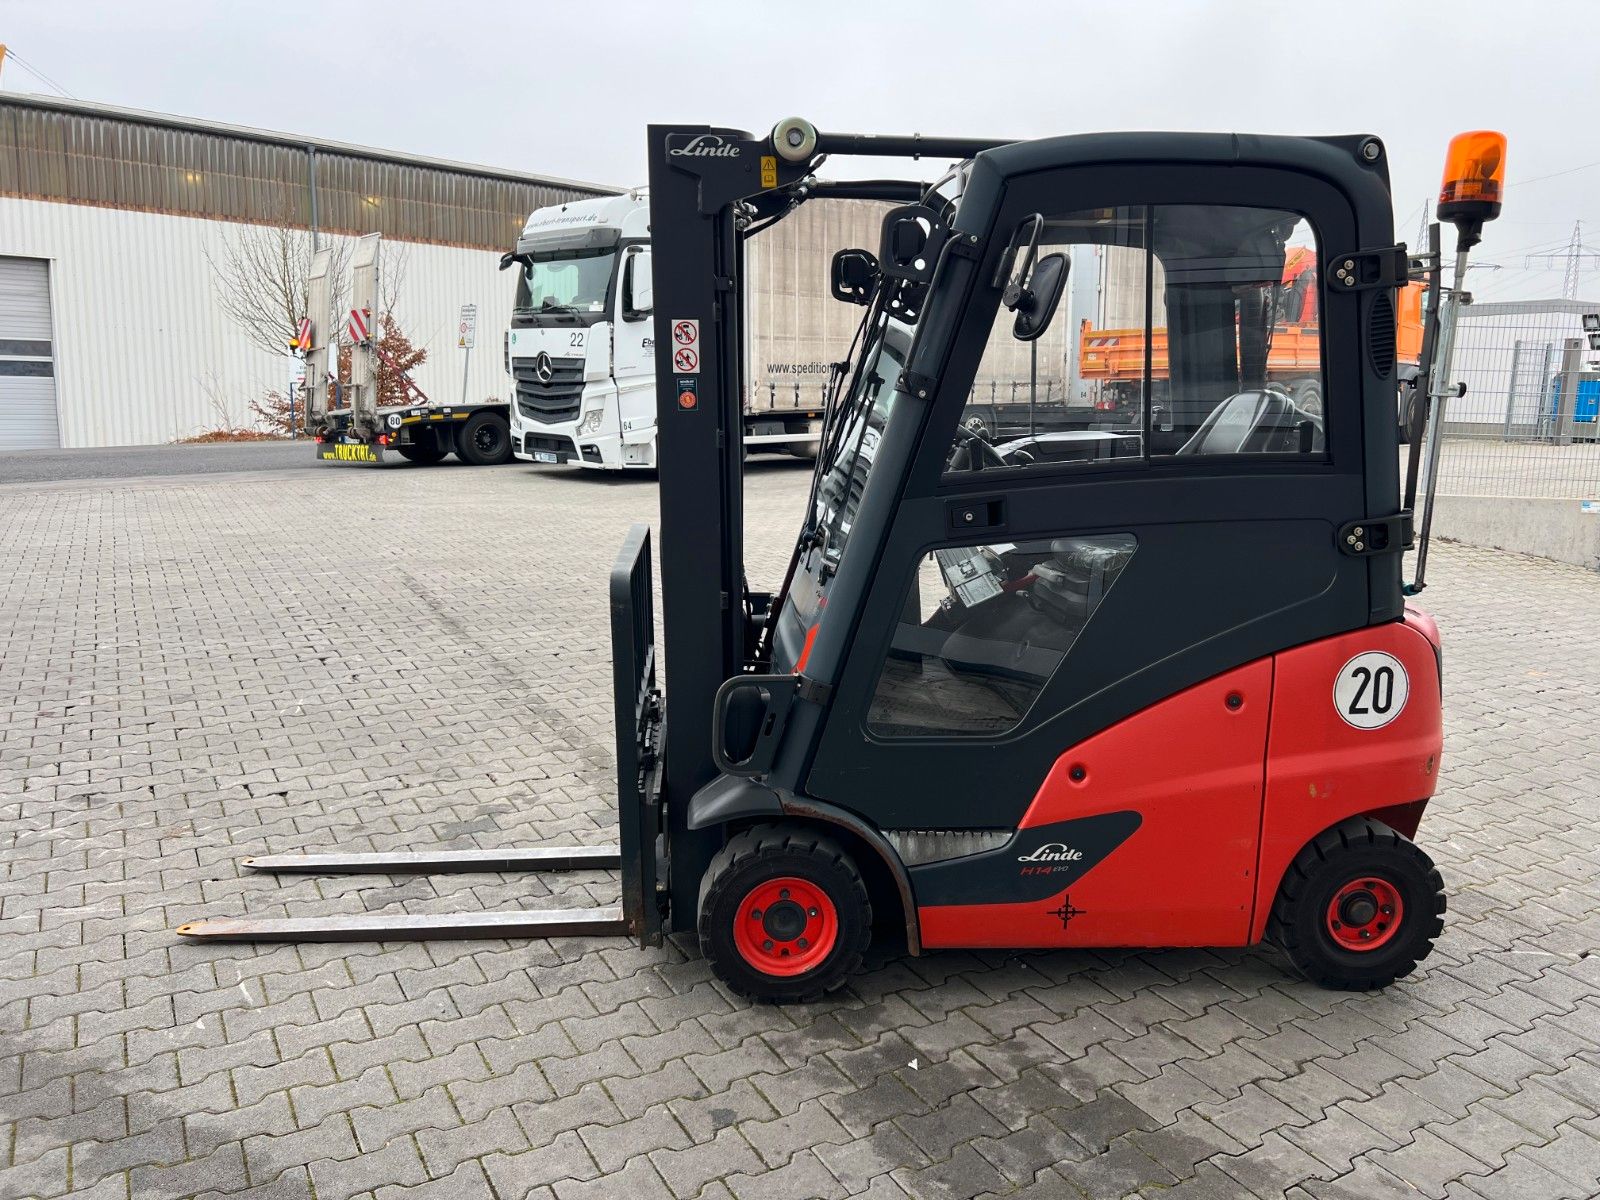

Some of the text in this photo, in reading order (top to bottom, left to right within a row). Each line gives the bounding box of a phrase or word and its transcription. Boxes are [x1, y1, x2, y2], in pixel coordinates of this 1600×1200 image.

[669, 134, 741, 157] Linde
[569, 332, 584, 347] 22
[390, 416, 400, 426] 80
[623, 421, 632, 431] 64
[1348, 666, 1394, 715] 20
[1017, 843, 1083, 861] Linde
[1020, 866, 1052, 876] H14
